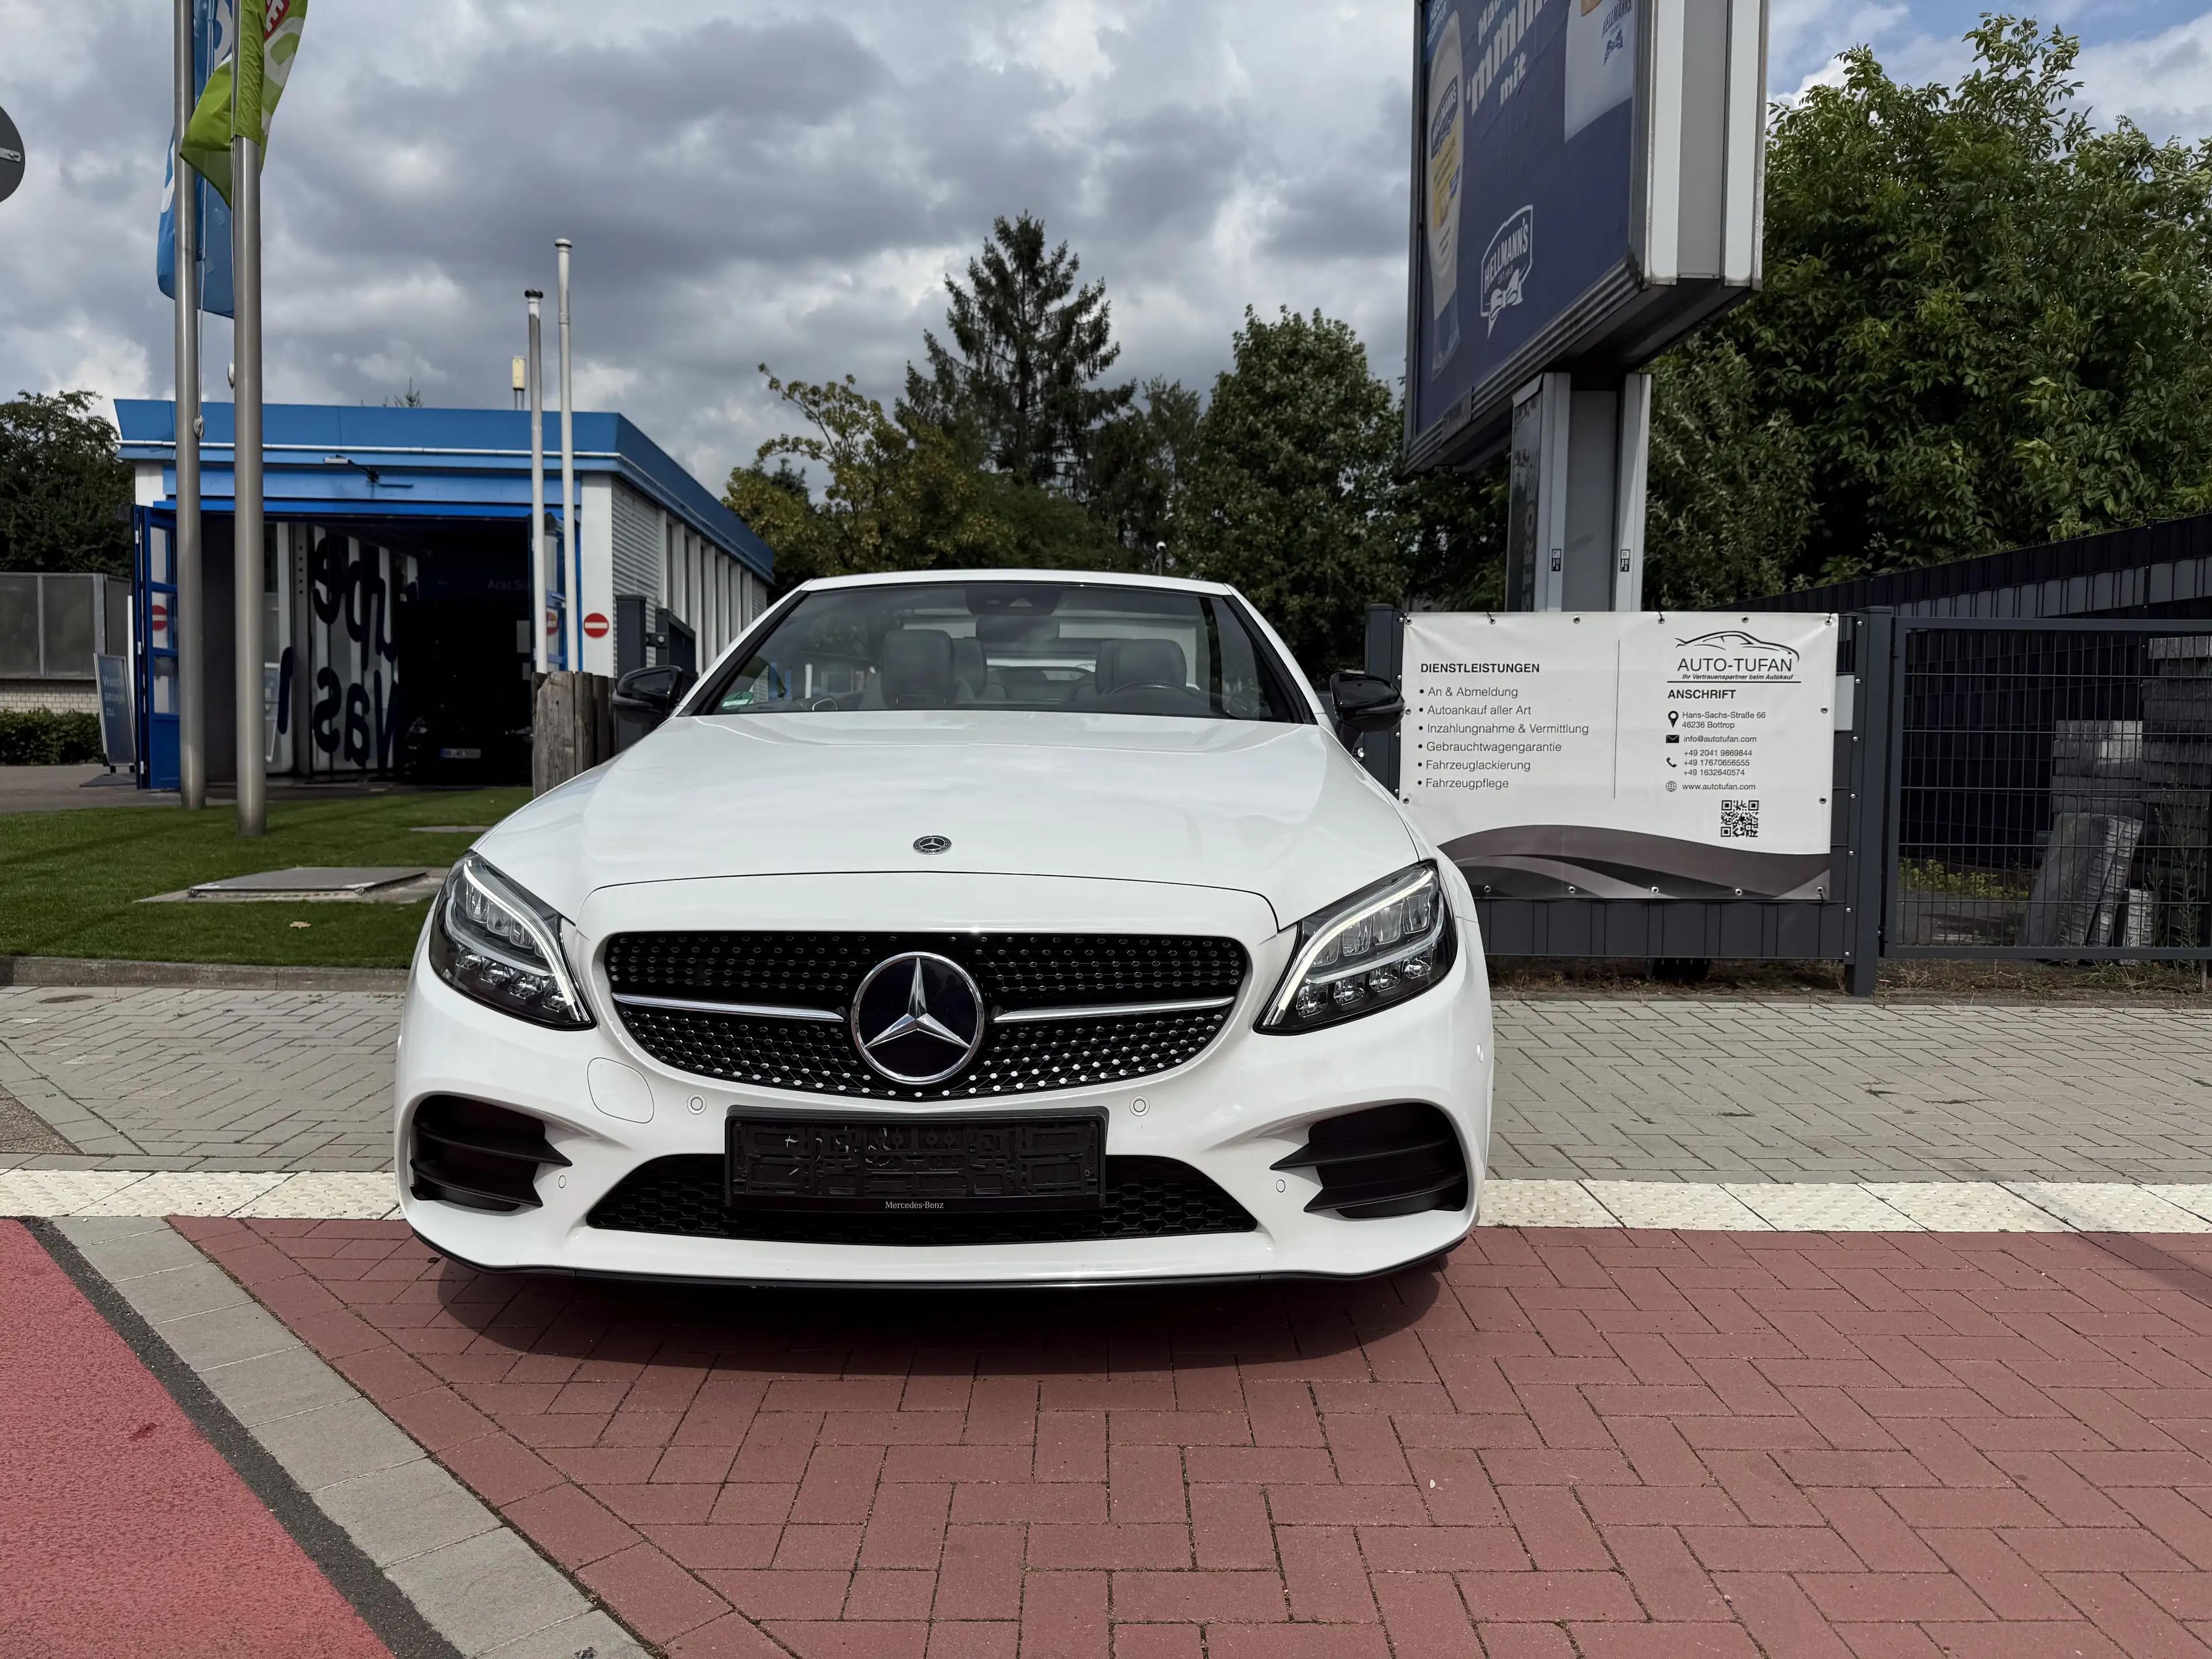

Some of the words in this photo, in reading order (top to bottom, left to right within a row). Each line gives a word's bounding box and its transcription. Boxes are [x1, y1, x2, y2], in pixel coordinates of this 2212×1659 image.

[1500, 52, 1526, 107] mit
[1484, 217, 1528, 294] HELLMANN'S
[1421, 662, 1540, 673] DIENSTLEISTUNGEN
[1677, 657, 1793, 672] AUTO-TUFAN
[1427, 686, 1442, 696] An
[1445, 687, 1453, 697] &
[1456, 686, 1518, 699] Abmeldung
[1667, 689, 1737, 699] ANSCHRIFT
[1427, 704, 1488, 715] Autoankauf
[1490, 704, 1513, 715] aller
[1515, 704, 1532, 715] Art
[1682, 711, 1755, 719] Hans-Sachs-Straße
[1427, 723, 1515, 736] Inzahlungnahme
[1517, 723, 1526, 733] &
[1529, 723, 1589, 736] Vermittlung
[1681, 721, 1706, 729] 46236
[1707, 721, 1735, 730] Bottrop
[1683, 734, 1757, 743] info@autotufan.com
[1426, 741, 1562, 754] Gebrauchtwagengarantie
[1699, 749, 1718, 757] 2041
[1720, 749, 1752, 757] 9869844
[1426, 759, 1531, 772] Fahrzeuglackierung
[1700, 759, 1750, 767] 17670656555
[1426, 778, 1509, 790] Fahrzeugpflege
[1681, 782, 1756, 790] www.autotufan.com
